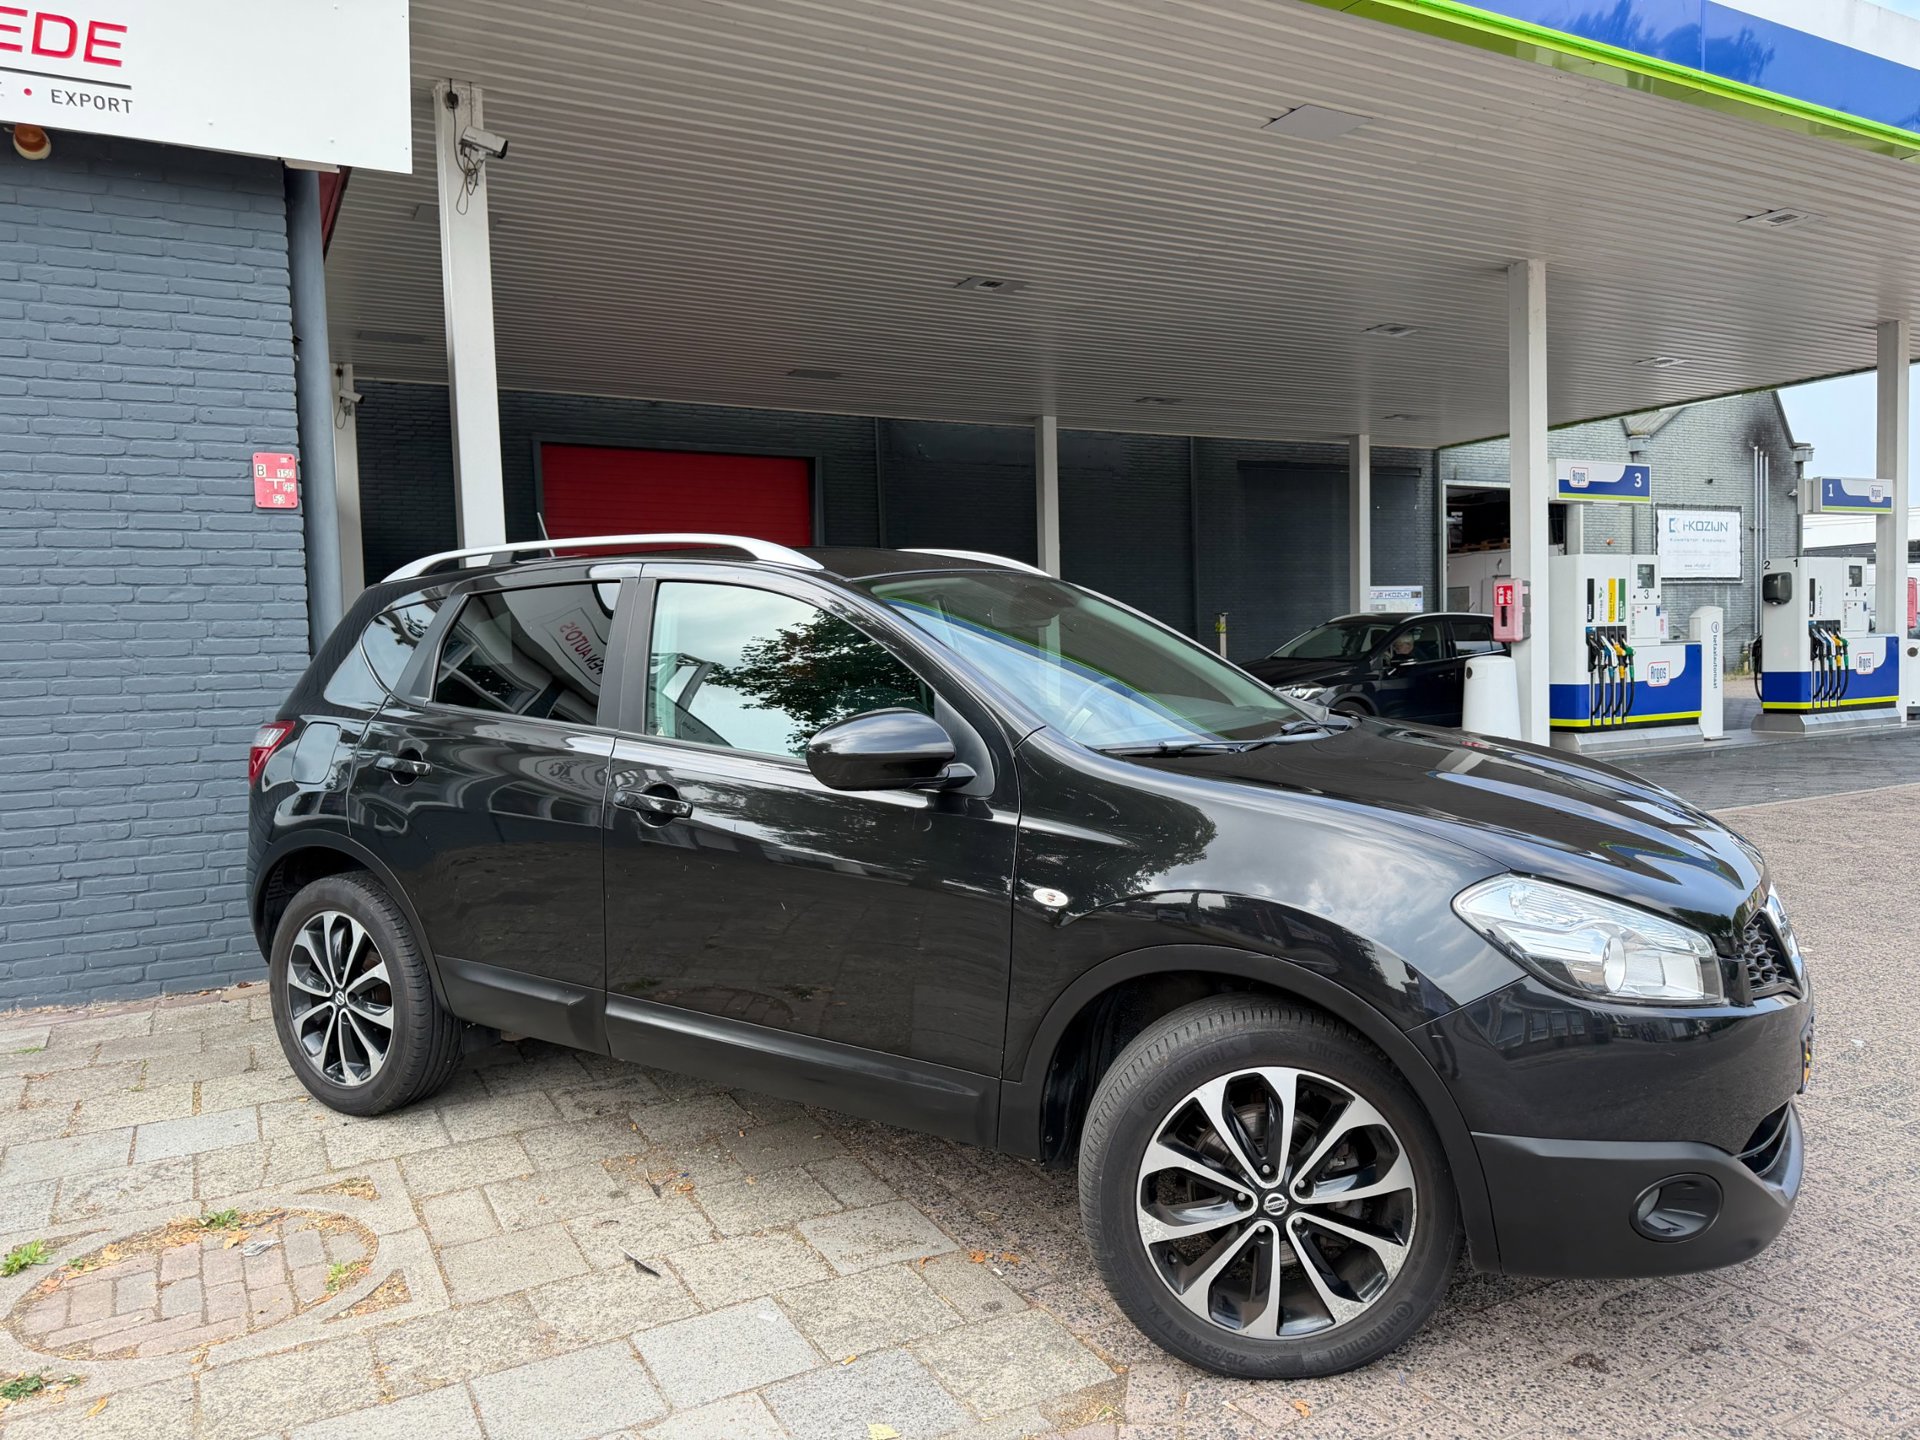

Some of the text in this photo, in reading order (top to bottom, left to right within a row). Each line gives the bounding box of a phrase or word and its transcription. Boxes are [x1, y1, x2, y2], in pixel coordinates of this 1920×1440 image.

[51, 89, 133, 114] EXPORT
[1634, 472, 1642, 488] 3
[1828, 483, 1834, 497] 1
[1763, 560, 1771, 570] 2
[1793, 558, 1798, 568] 1
[1643, 589, 1650, 600] 3
[1650, 665, 1667, 682] Argos
[1327, 1300, 1414, 1364] Continental
